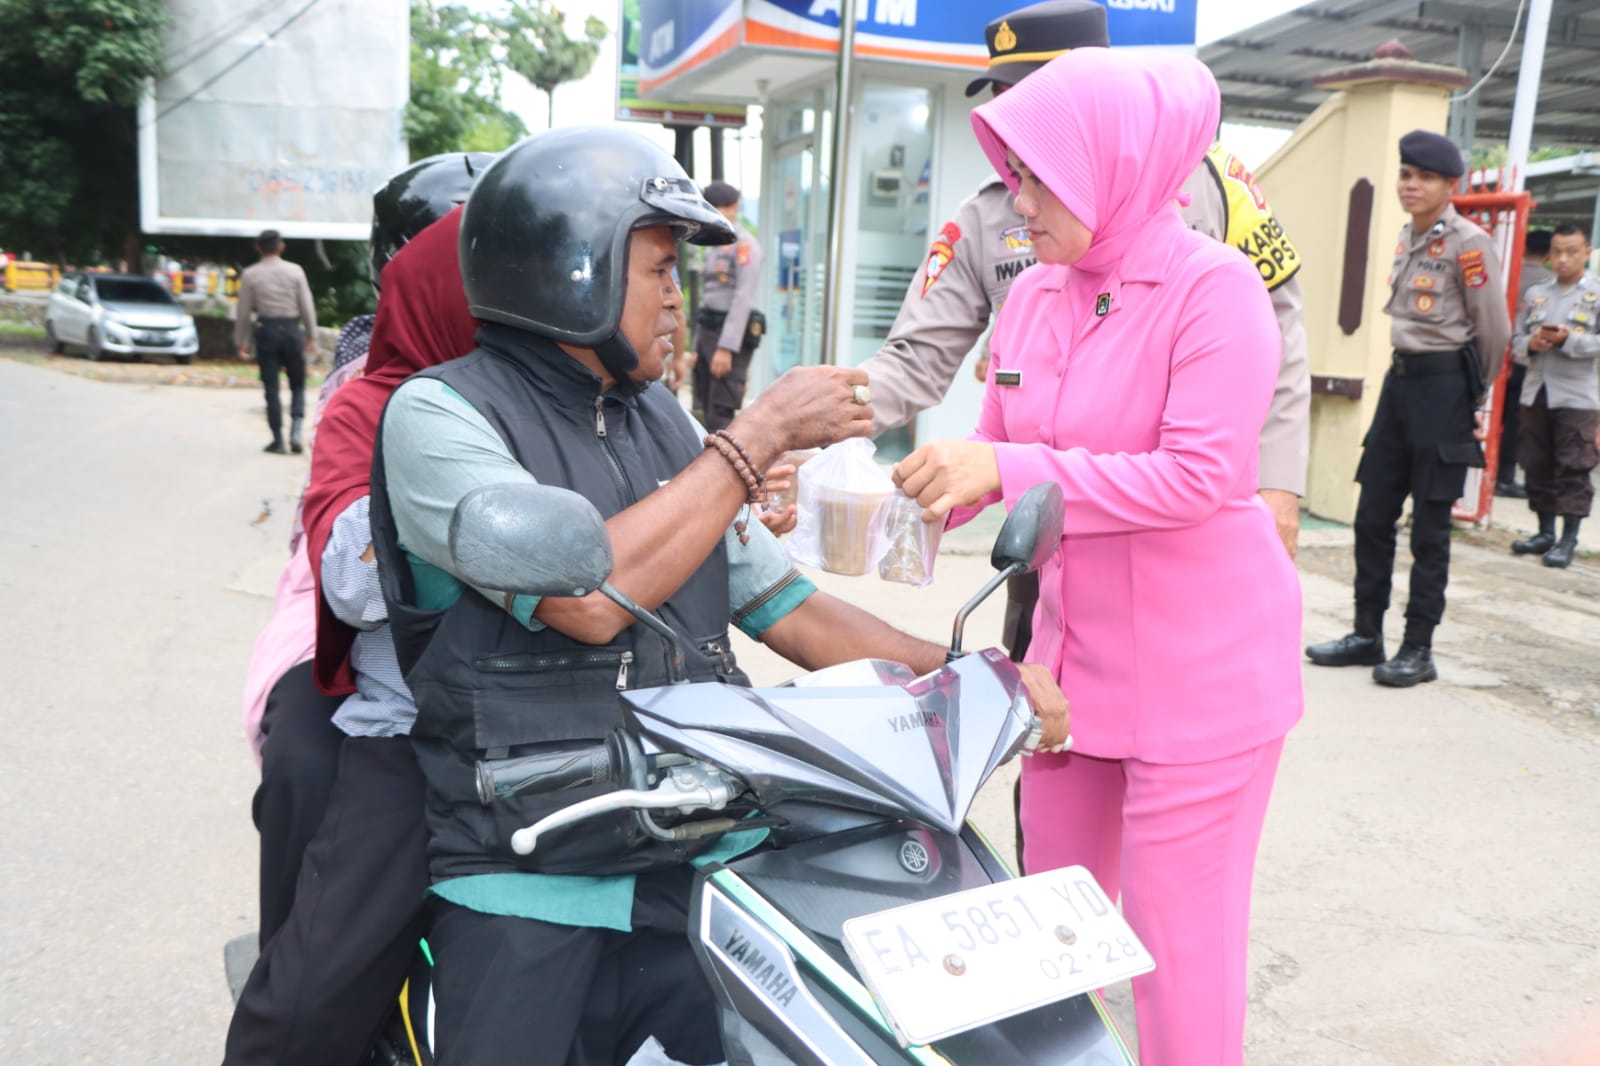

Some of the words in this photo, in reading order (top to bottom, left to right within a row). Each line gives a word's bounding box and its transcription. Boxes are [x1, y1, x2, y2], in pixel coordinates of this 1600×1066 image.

[808, 0, 916, 28] AM
[1255, 240, 1296, 282] OPS
[888, 711, 939, 733] YAMAHA
[864, 924, 930, 974] EA
[941, 895, 1044, 951] 5851
[1051, 879, 1110, 922] YD
[723, 929, 799, 1008] YAMAHA
